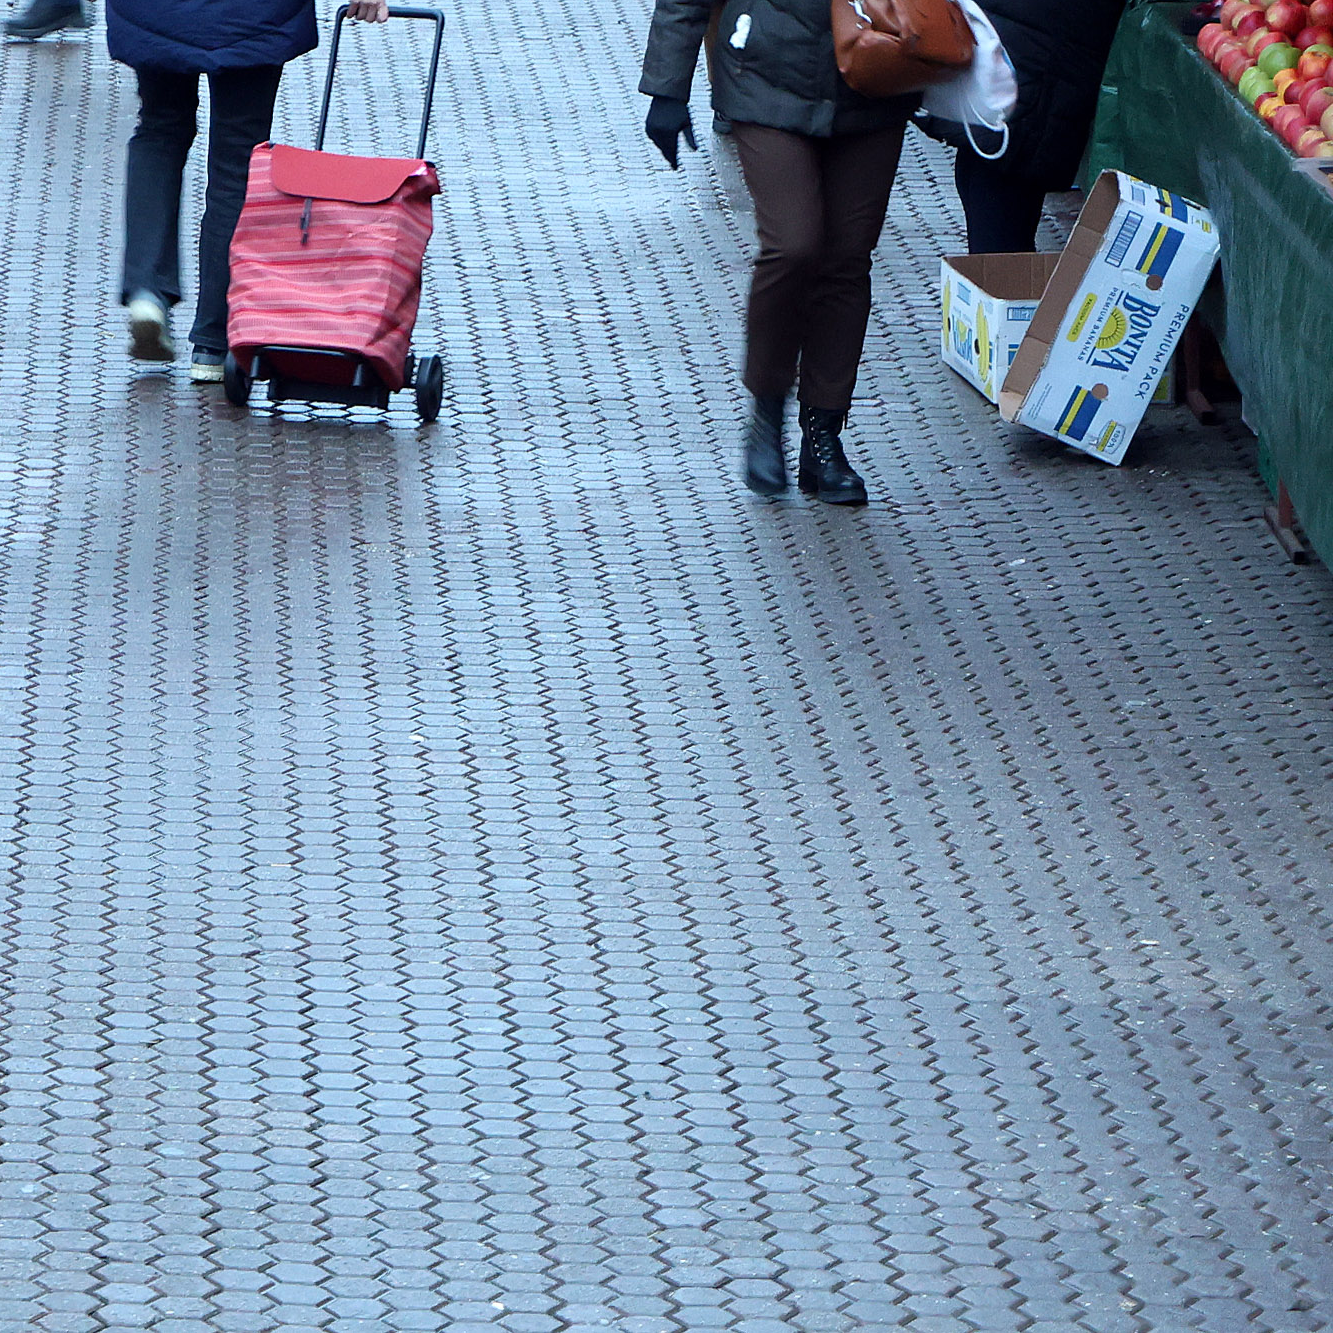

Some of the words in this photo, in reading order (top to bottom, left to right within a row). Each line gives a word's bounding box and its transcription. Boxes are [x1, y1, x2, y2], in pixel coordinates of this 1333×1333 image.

[1099, 287, 1120, 323] PREMIUM
[1077, 324, 1101, 361] BANANAS
[1091, 291, 1162, 374] BONITA
[1153, 303, 1190, 364] PREMIUM
[1134, 365, 1159, 398] PACK
